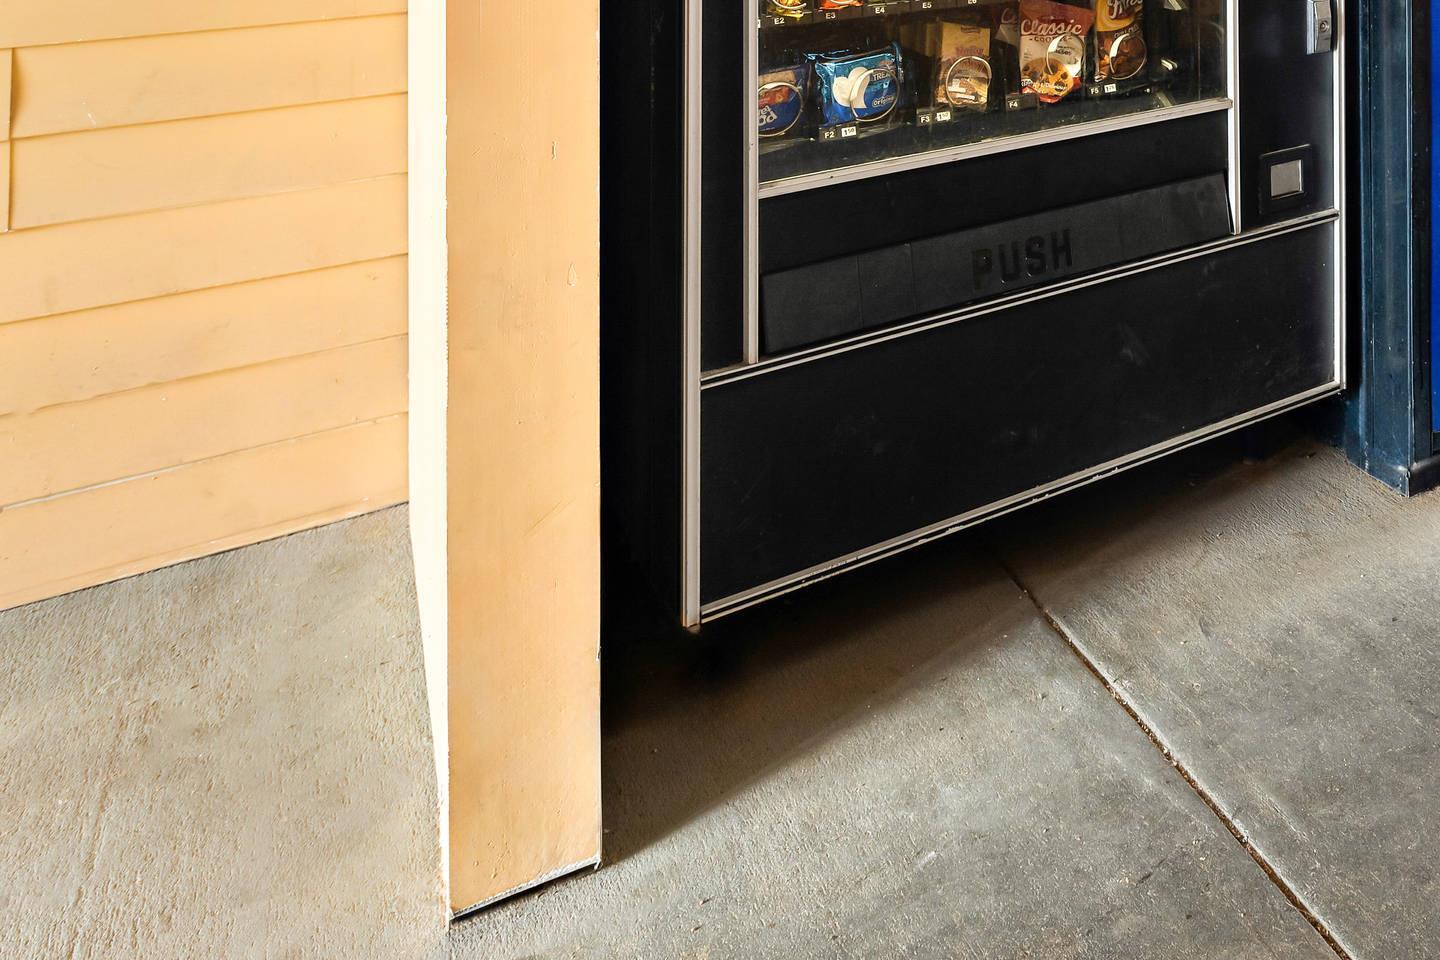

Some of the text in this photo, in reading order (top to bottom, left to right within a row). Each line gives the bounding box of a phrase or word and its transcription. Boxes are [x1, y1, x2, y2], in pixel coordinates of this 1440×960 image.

[825, 12, 836, 20] E3
[774, 17, 785, 25] E2
[1021, 18, 1082, 35] Classic
[1008, 101, 1018, 109] F4
[920, 115, 930, 123] F3
[824, 131, 835, 139] F2
[971, 228, 1074, 290] PUSH
